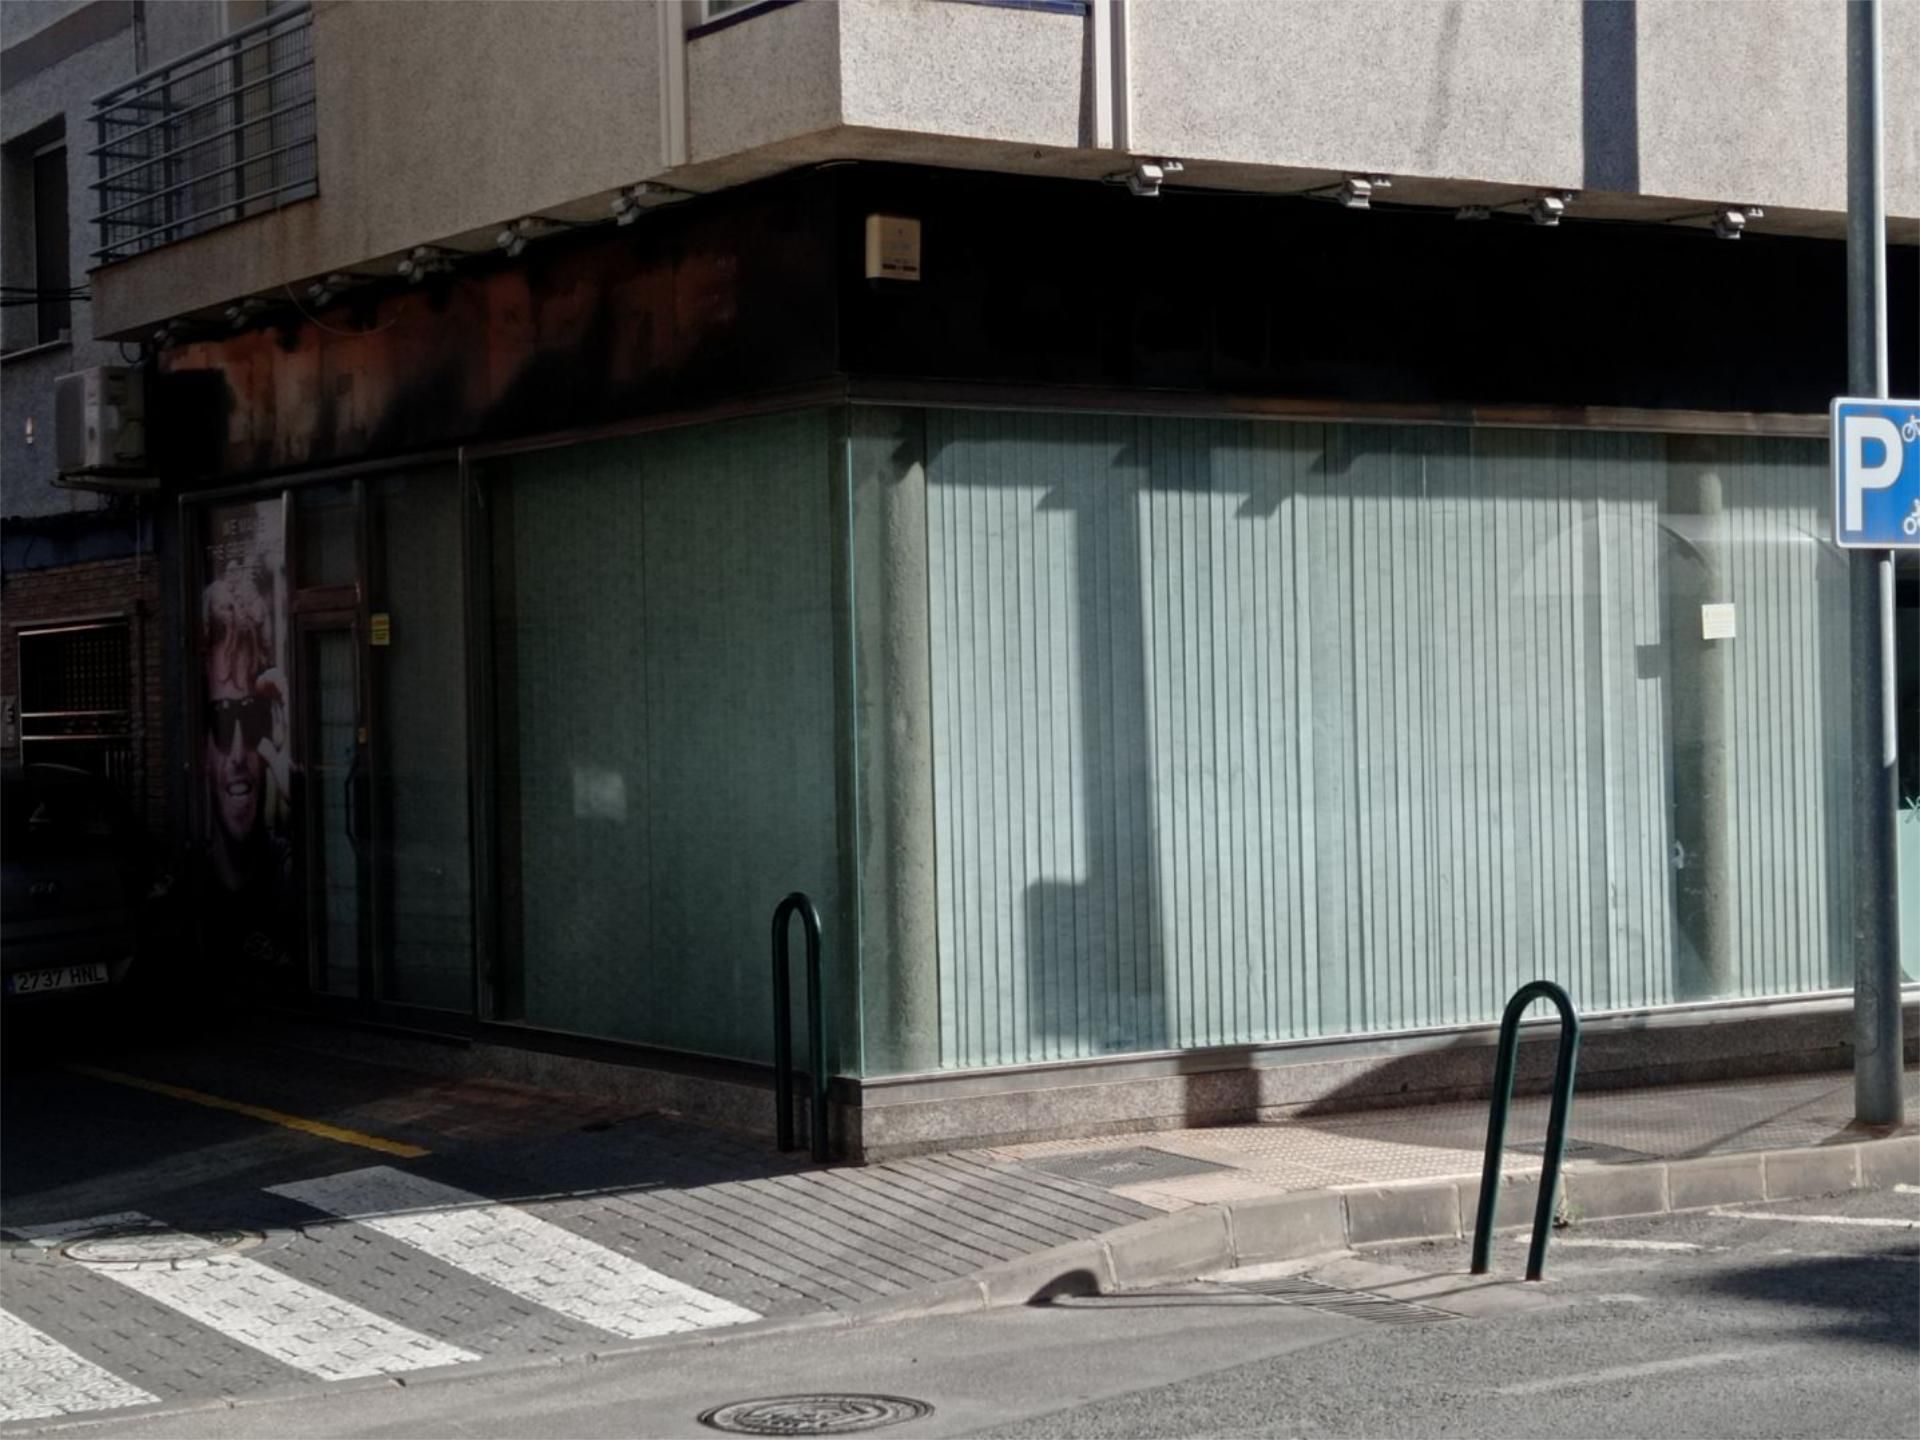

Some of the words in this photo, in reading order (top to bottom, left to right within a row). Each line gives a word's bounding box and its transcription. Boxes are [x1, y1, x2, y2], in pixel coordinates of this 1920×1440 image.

[1844, 416, 1904, 532] P
[18, 970, 63, 991] 2737
[70, 965, 105, 983] HNL
